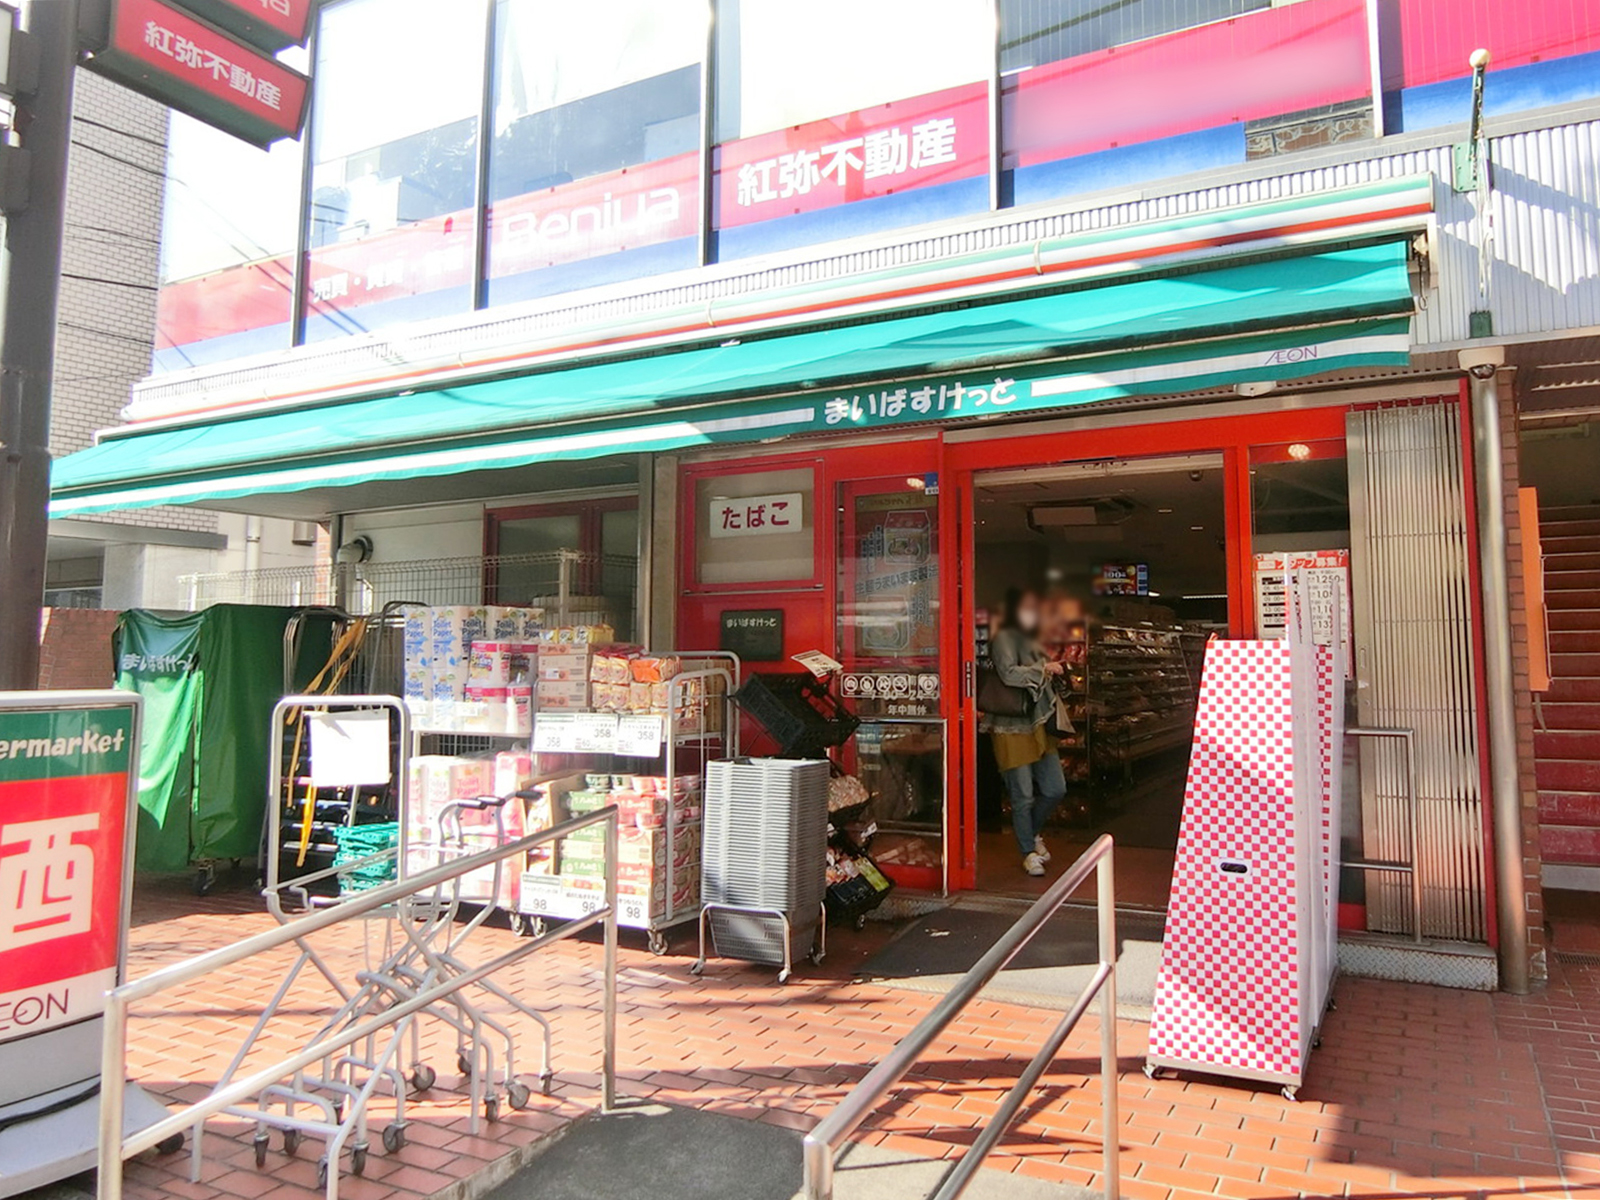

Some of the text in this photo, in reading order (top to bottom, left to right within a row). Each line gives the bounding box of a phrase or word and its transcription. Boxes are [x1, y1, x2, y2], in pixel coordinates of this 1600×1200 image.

[145, 20, 281, 111] 紅弥不動産
[737, 117, 957, 207] 紅弥不動産
[824, 377, 1017, 425] まいばすけっと
[722, 502, 789, 530] たばこ
[594, 728, 612, 738] 358
[637, 730, 655, 740] 358
[533, 898, 548, 910] 98
[582, 901, 597, 913] 98
[626, 906, 641, 919] 98
